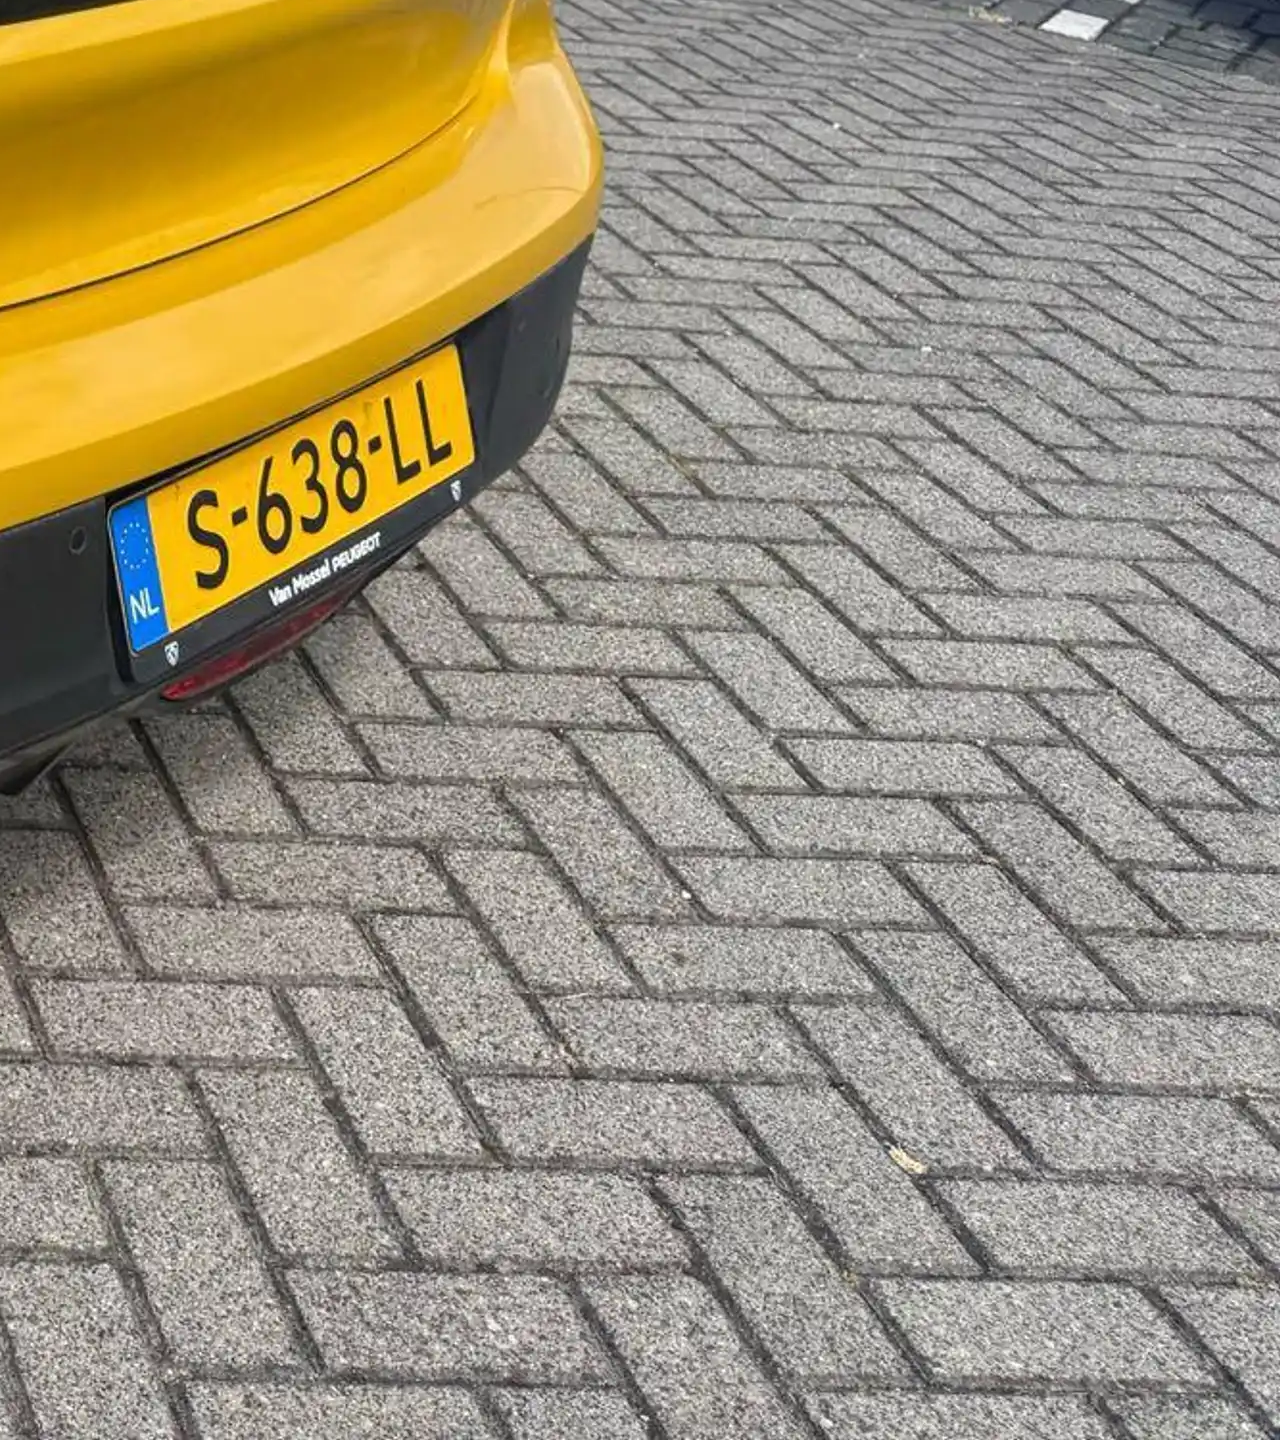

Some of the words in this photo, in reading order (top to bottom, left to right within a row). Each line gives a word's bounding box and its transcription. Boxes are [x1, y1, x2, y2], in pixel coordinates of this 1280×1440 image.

[186, 378, 453, 591] S-638-LL
[130, 588, 160, 625] NL
[268, 585, 293, 607] Van
[291, 558, 332, 596] Mossel
[331, 531, 382, 573] PEUGEOT
